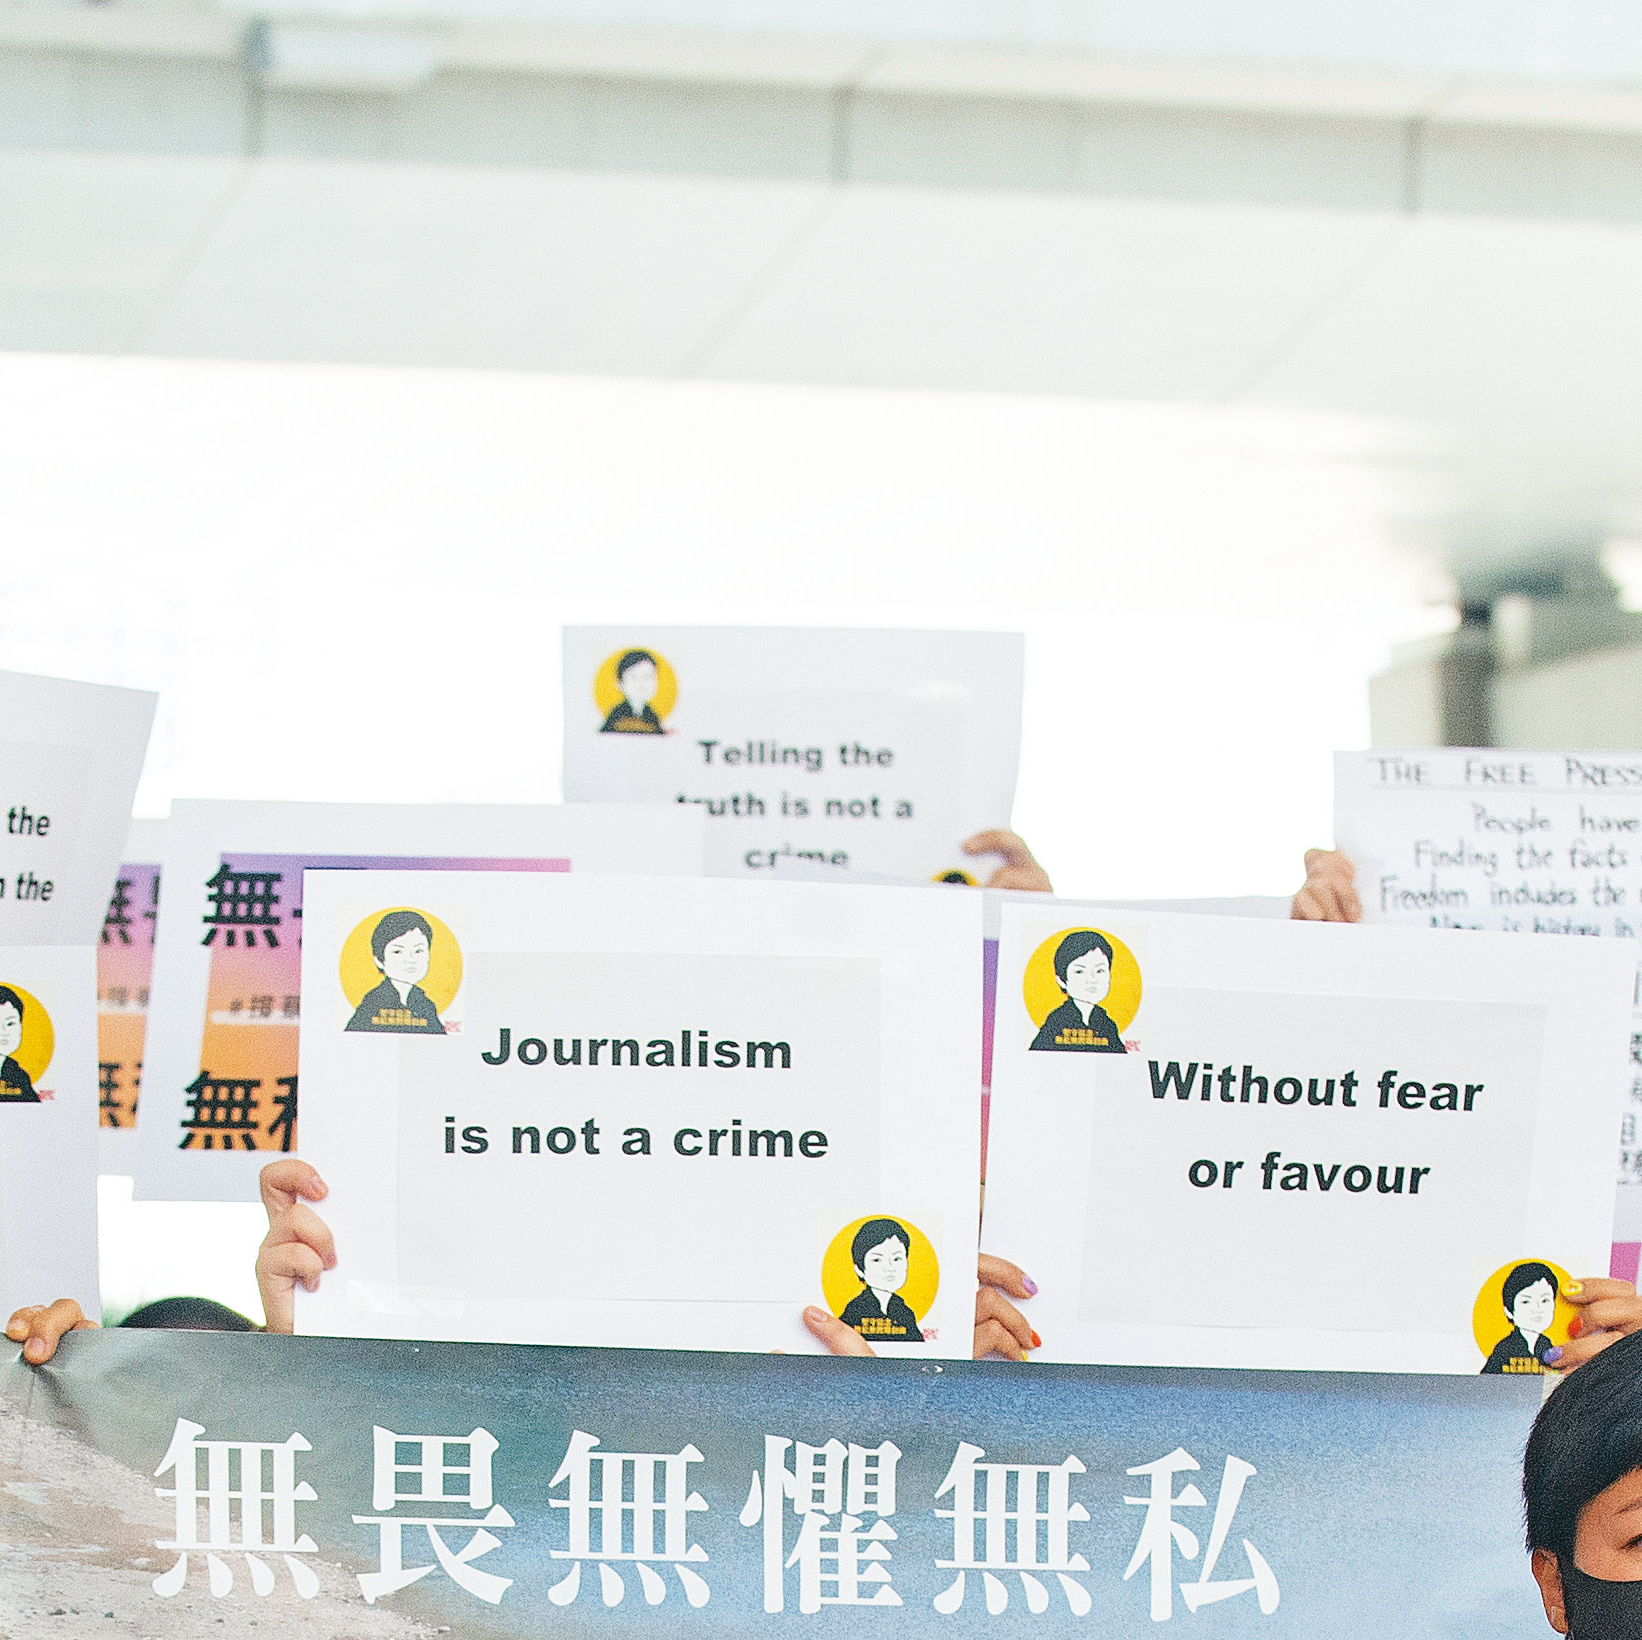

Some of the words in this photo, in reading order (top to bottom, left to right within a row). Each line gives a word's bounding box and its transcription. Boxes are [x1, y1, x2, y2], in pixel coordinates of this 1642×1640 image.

[698, 740, 824, 772] Telling
[839, 740, 894, 767] the
[1464, 758, 1534, 784] FREE
[782, 791, 809, 817] is
[825, 795, 881, 818] not
[896, 798, 914, 819] a
[1579, 803, 1640, 832] have
[8, 806, 50, 836] the
[1516, 842, 1553, 869] the
[16, 872, 54, 901] the
[481, 1027, 793, 1069] Journalism
[1148, 1059, 1359, 1108] Without
[1377, 1069, 1484, 1113] fear
[444, 1116, 489, 1155] is
[511, 1117, 601, 1156] not
[622, 1124, 652, 1157] a
[674, 1119, 829, 1159] crime
[1188, 1155, 1243, 1190] or
[1261, 1152, 1430, 1196] favour
[152, 1415, 1279, 1622] 無畏無懼無私
